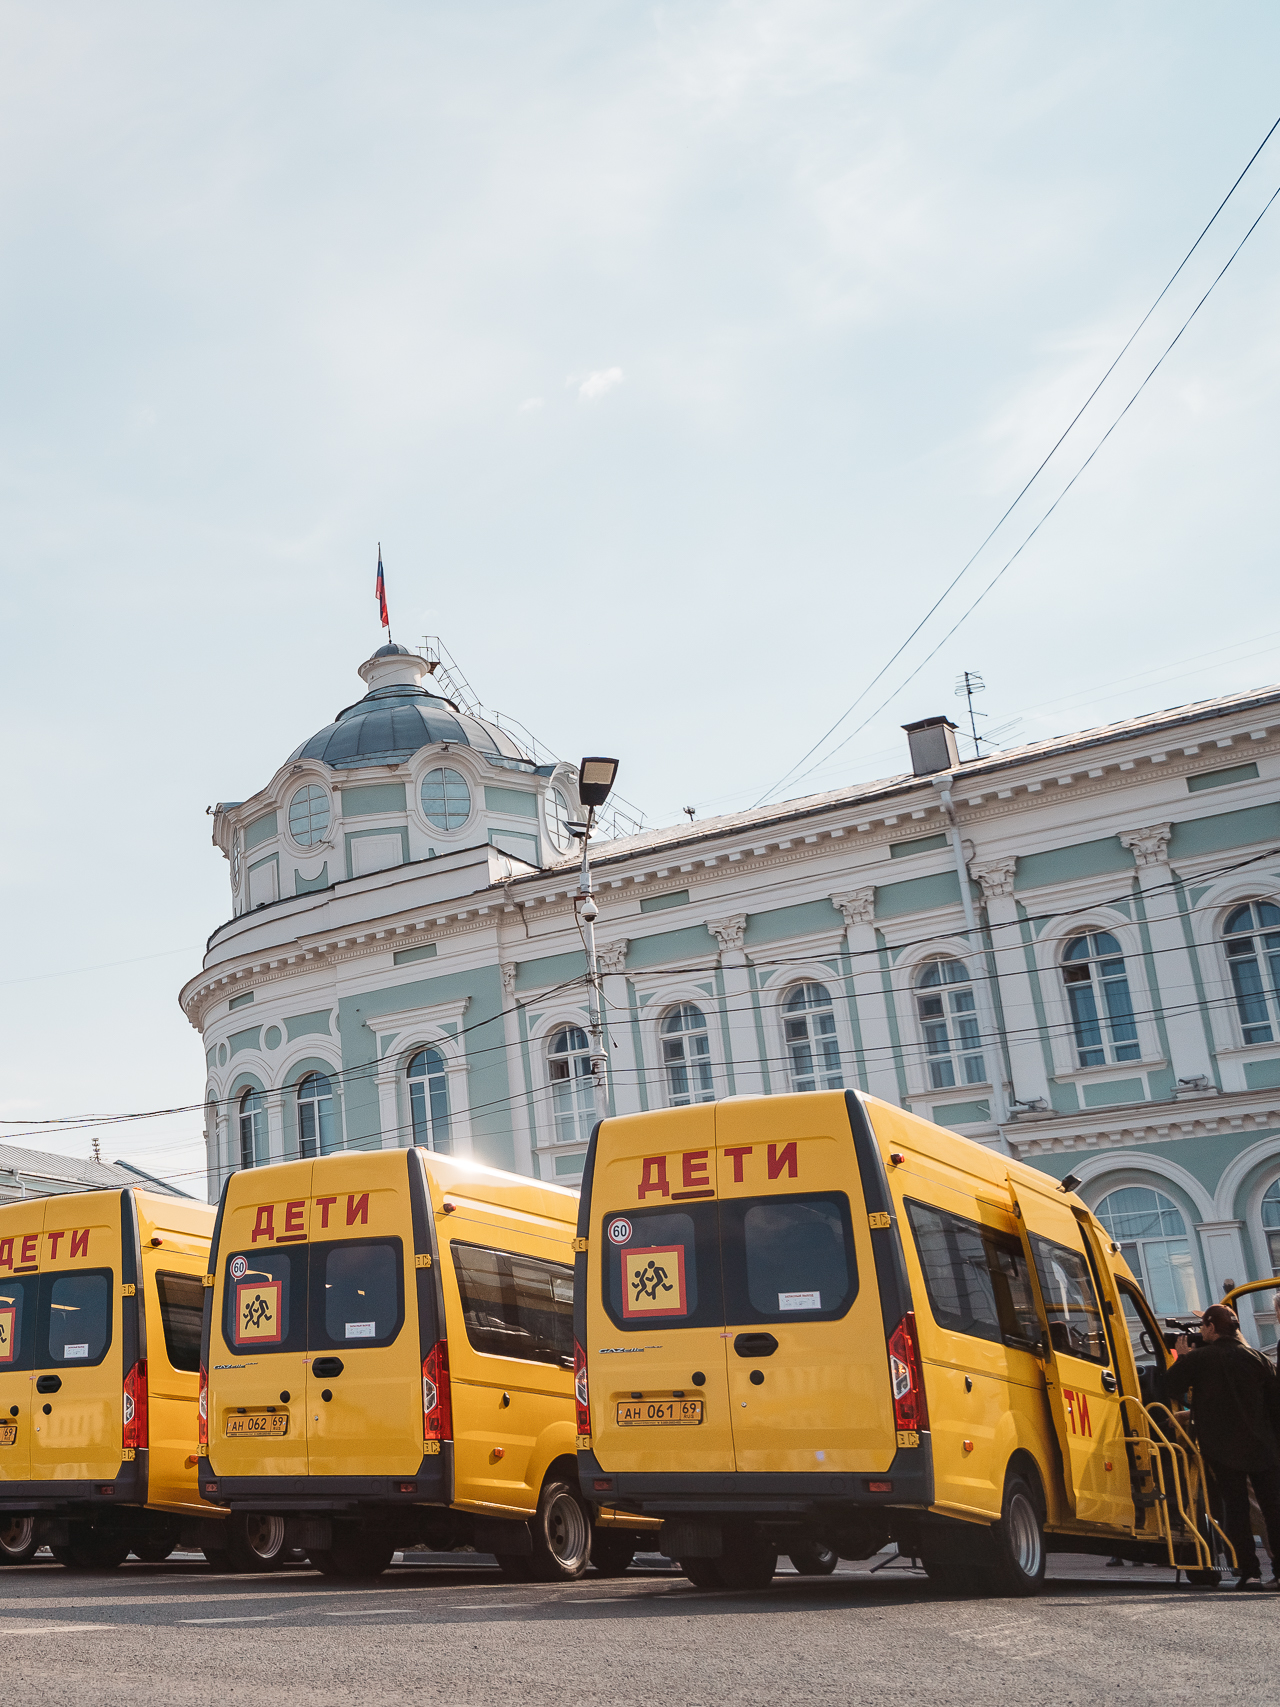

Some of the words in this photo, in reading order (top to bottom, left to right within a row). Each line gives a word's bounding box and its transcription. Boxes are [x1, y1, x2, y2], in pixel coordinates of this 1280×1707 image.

[638, 1142, 798, 1199] ДЕТИ
[252, 1193, 370, 1242] ДЕТИ
[613, 1224, 627, 1237] 60
[234, 1261, 245, 1273] 60
[624, 1407, 641, 1419] АН
[647, 1404, 673, 1419] 061
[682, 1402, 697, 1414] 69
[1063, 1388, 1093, 1438] ТИ
[231, 1421, 244, 1431] АН
[248, 1418, 267, 1430] 062
[272, 1416, 284, 1426] 69
[4, 1427, 13, 1437] 69
